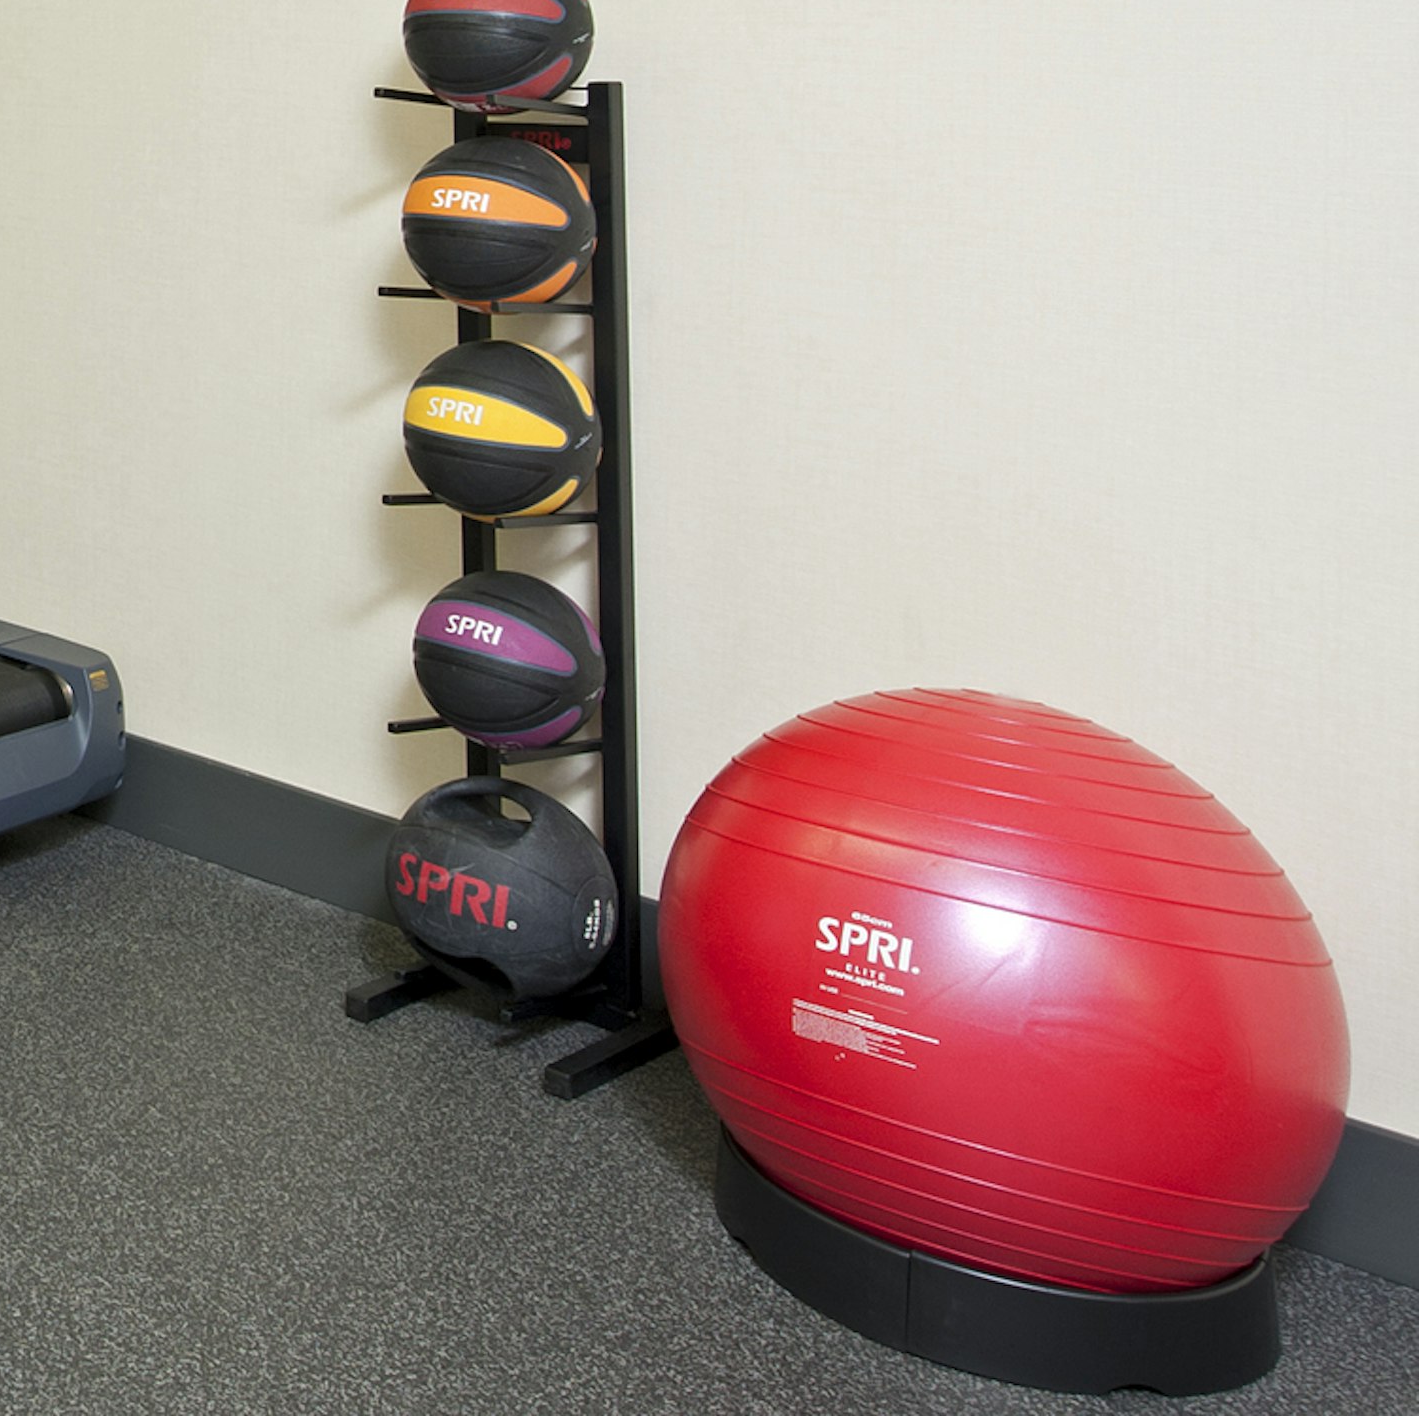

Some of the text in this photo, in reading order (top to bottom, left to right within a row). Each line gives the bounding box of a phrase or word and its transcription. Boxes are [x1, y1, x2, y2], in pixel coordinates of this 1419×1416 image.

[431, 188, 490, 213] SPRI
[427, 397, 483, 426] SPRI
[445, 614, 503, 646] SPRI
[395, 852, 510, 930] SPRI
[815, 916, 913, 973] SPRI
[845, 963, 886, 982] ELITE
